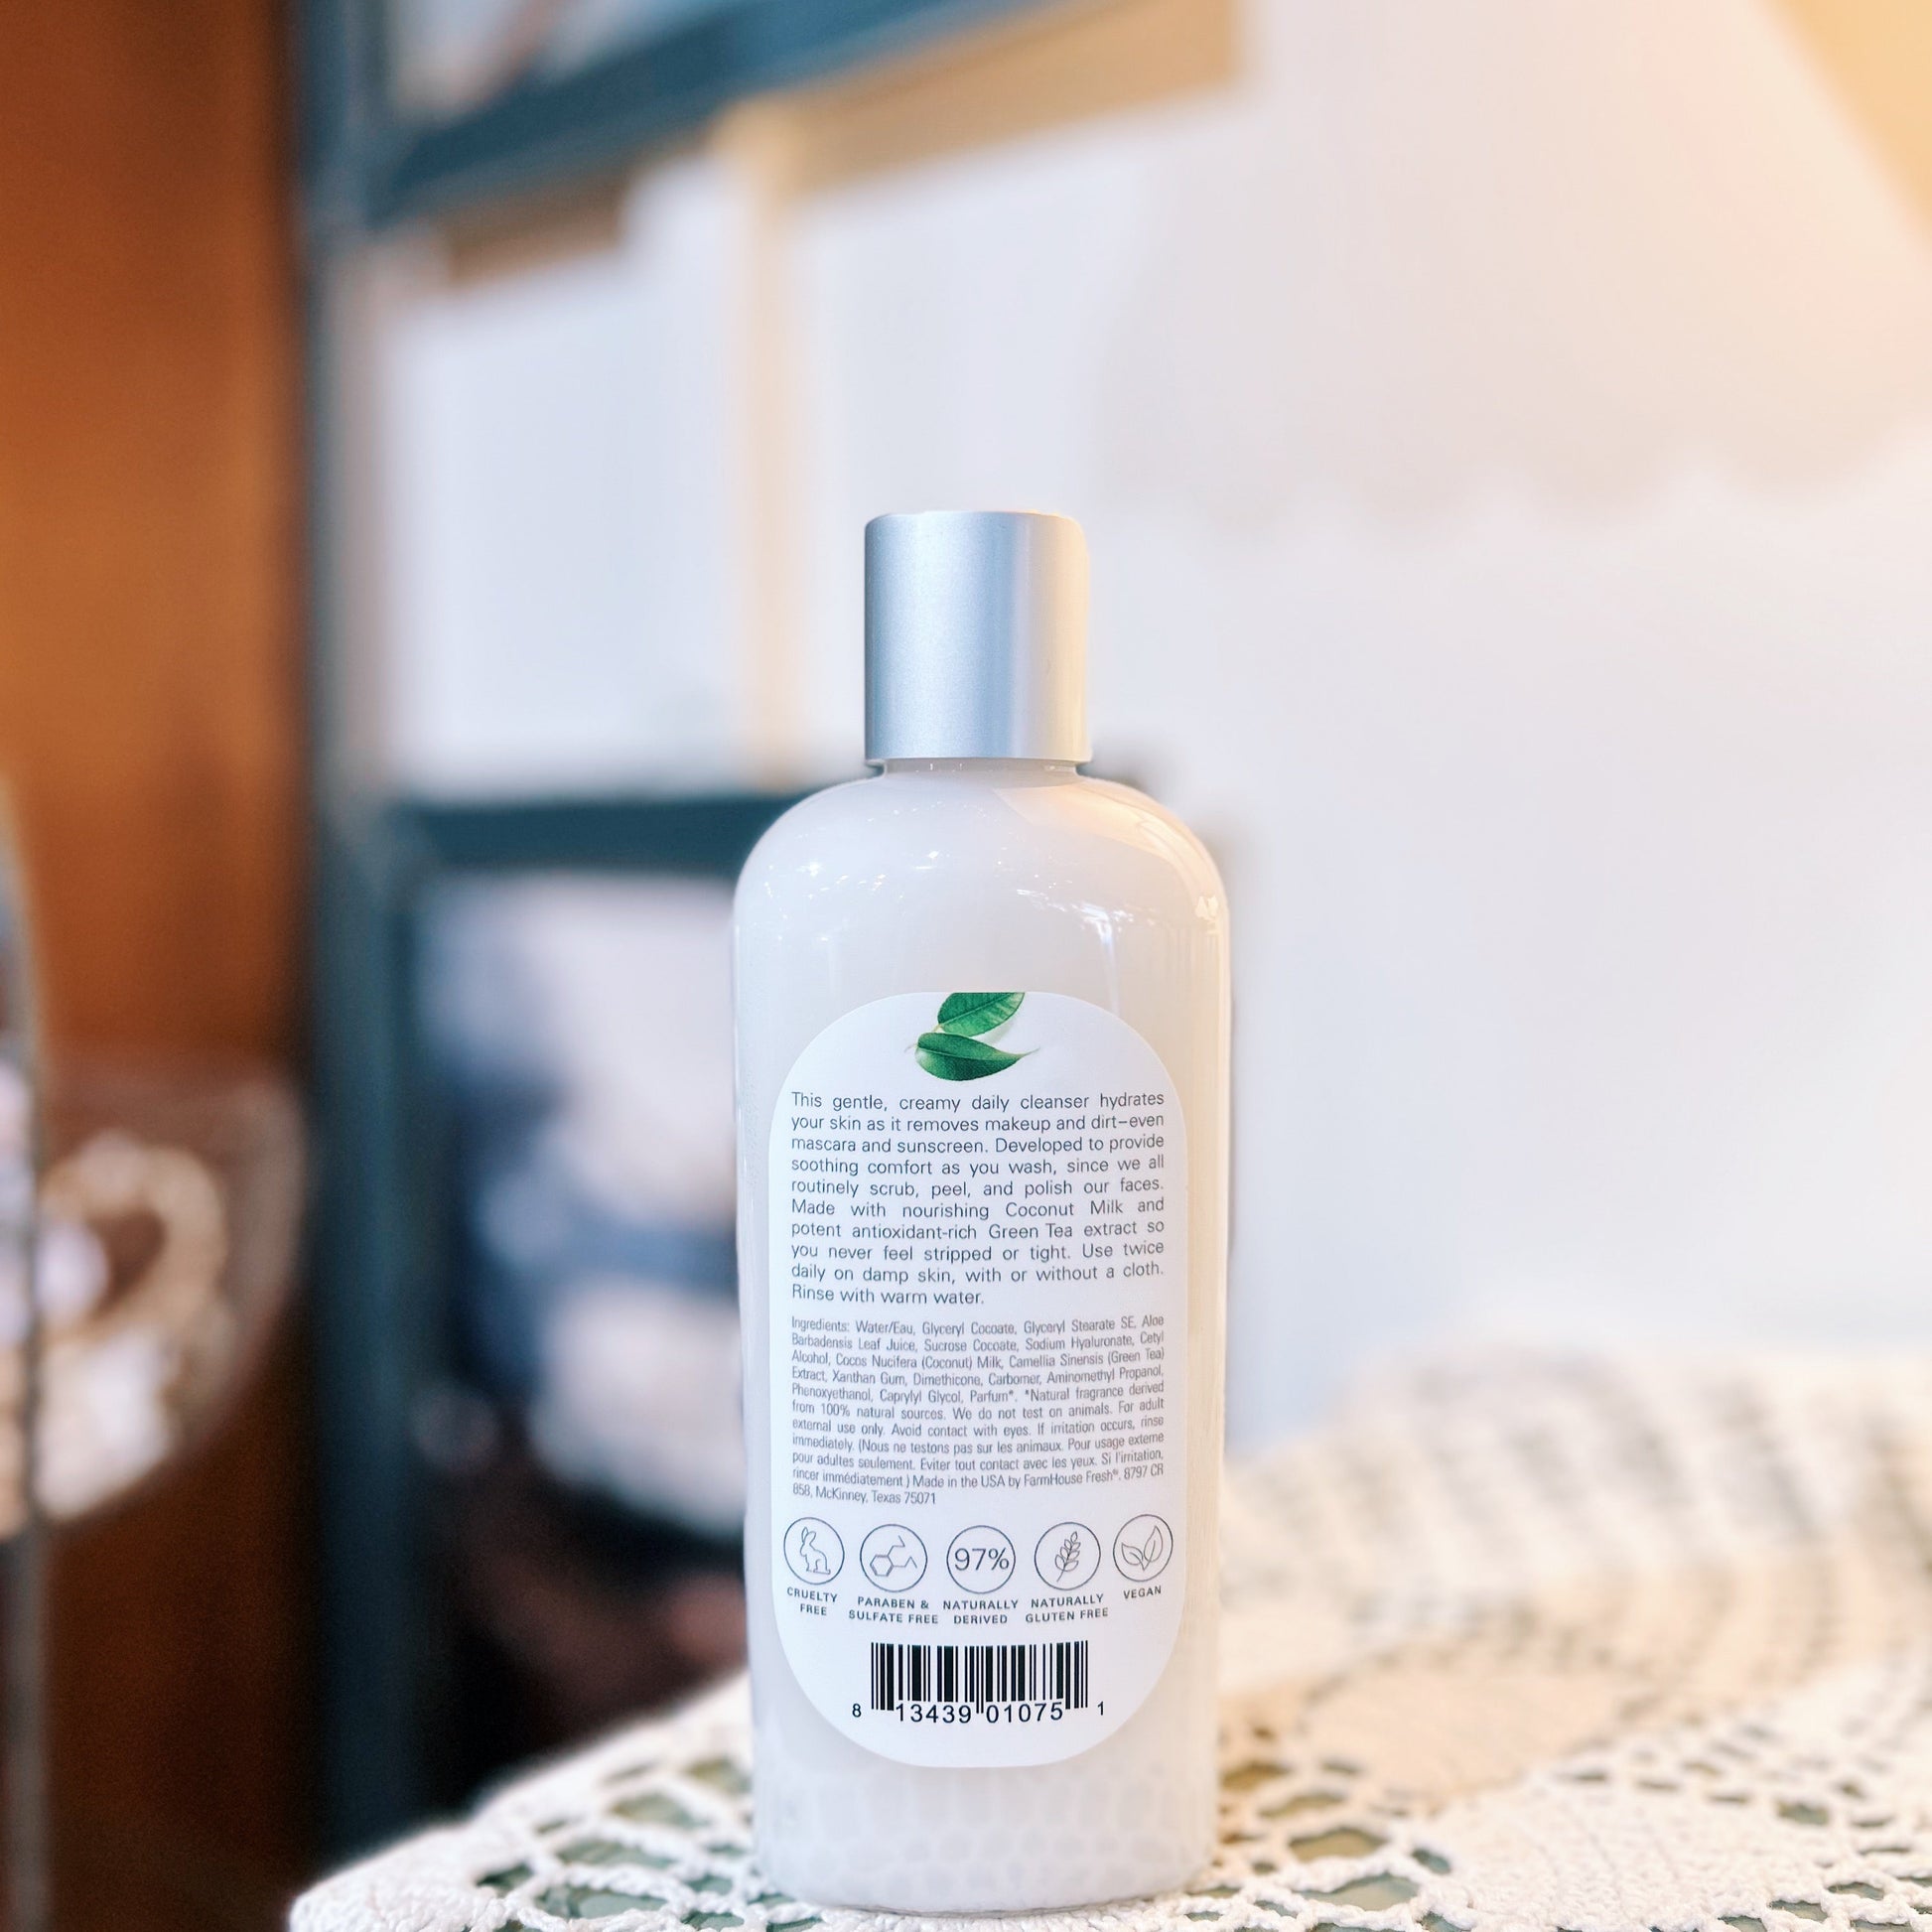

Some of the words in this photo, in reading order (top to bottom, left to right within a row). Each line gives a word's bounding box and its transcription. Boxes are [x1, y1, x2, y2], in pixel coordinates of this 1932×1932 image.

[791, 1090, 822, 1108] This
[832, 1092, 888, 1114] gentle,
[898, 1097, 961, 1114] creamy
[971, 1093, 1010, 1114] daily
[1020, 1092, 1089, 1110] cleanser
[1099, 1088, 1165, 1112] hydrates
[790, 1115, 824, 1133] your
[829, 1113, 861, 1131] skin
[866, 1118, 886, 1131] as
[891, 1115, 901, 1132] it
[906, 1119, 979, 1132] removes
[984, 1114, 1051, 1135] makeup
[1055, 1113, 1085, 1131] and
[791, 1136, 856, 1152] mascara
[861, 1136, 892, 1153] and
[897, 1140, 988, 1153] sunscreen.
[995, 1135, 1083, 1157] Developed
[1088, 1134, 1104, 1151] to
[1109, 1131, 1164, 1154] provide
[791, 1154, 859, 1176] soothing
[867, 1157, 932, 1174] comfort
[940, 1162, 960, 1174] as
[969, 1162, 999, 1178] you
[1008, 1157, 1056, 1177] wash,
[1066, 1155, 1109, 1173] since
[1116, 1157, 1141, 1171] we
[1148, 1152, 1164, 1169] all
[791, 1174, 859, 1198] routinely
[869, 1178, 919, 1199] scrub,
[930, 1179, 971, 1199] peel,
[982, 1178, 1014, 1195] and
[1024, 1177, 1072, 1198] polish
[1082, 1179, 1109, 1193] our
[1119, 1173, 1163, 1191] faces.
[791, 1196, 835, 1215] Made
[850, 1199, 886, 1217] with
[901, 1200, 989, 1221] nourishing
[1005, 1199, 1074, 1217] Coconut
[1089, 1196, 1123, 1215] Milk
[1137, 1193, 1164, 1212] and
[791, 1217, 841, 1240] potent
[851, 1220, 977, 1239] antioxidant-rich
[988, 1221, 1038, 1239] Green
[1044, 1220, 1072, 1238] Tea
[1083, 1217, 1137, 1236] extract
[1147, 1218, 1165, 1232] so
[790, 1242, 818, 1261] you
[828, 1245, 873, 1260] never
[883, 1243, 913, 1261] feel
[923, 1244, 992, 1265] stripped
[1002, 1247, 1020, 1261] or
[1030, 1242, 1070, 1264] tight.
[1081, 1240, 1113, 1258] Use
[1122, 1236, 1164, 1256] twice
[790, 1260, 826, 1283] daily
[833, 1266, 854, 1280] on
[862, 1264, 909, 1286] damp
[917, 1265, 955, 1286] skin,
[964, 1265, 1002, 1282] with
[1010, 1268, 1028, 1282] or
[1035, 1262, 1097, 1281] without
[1105, 1265, 1115, 1278] a
[1122, 1257, 1163, 1277] cloth.
[791, 1282, 835, 1301] Rinse
[839, 1285, 875, 1303] with
[880, 1290, 927, 1304] warm
[932, 1287, 984, 1304] water.
[921, 1321, 965, 1337] Glyceryl
[1023, 1319, 1065, 1337] Glyceryl
[791, 1332, 853, 1349] Barbadensis
[858, 1336, 881, 1350] Leaf
[923, 1338, 967, 1351] Sucrose
[1025, 1336, 1065, 1350] Sodium
[835, 1352, 868, 1367] Cocos
[871, 1354, 917, 1368] Nucifera
[920, 1355, 973, 1371] (Coconut)
[1008, 1353, 1055, 1368] Camellia
[1059, 1351, 1104, 1366] Sinensis
[831, 1369, 876, 1384] Xanthan
[879, 1388, 922, 1405] Caprylyl
[1074, 1383, 1124, 1402] fragrance
[791, 1399, 815, 1414] from
[820, 1402, 851, 1416] 100%
[856, 1404, 895, 1418] natural
[951, 1406, 972, 1419] We
[977, 1406, 993, 1419] do
[997, 1406, 1016, 1419] not
[1022, 1405, 1043, 1418] test
[1047, 1406, 1062, 1417] on
[1118, 1399, 1134, 1413] For
[1138, 1395, 1165, 1411] adult
[836, 1422, 856, 1434] use
[890, 1423, 922, 1437] Avoid
[926, 1424, 968, 1437] contact
[972, 1424, 998, 1437] with
[1036, 1422, 1044, 1435] If
[1140, 1413, 1164, 1428] rinse
[857, 1438, 890, 1455] (Nous
[893, 1442, 906, 1452] ne
[909, 1440, 950, 1453] testons
[952, 1443, 973, 1456] pas
[976, 1443, 993, 1453] sur
[996, 1440, 1013, 1453] les
[1067, 1437, 1091, 1450] Pour
[1094, 1436, 1125, 1451] usage
[954, 1457, 976, 1470] tout
[979, 1456, 1020, 1470] contact
[1022, 1457, 1048, 1469] avec
[1050, 1454, 1067, 1468] les
[1100, 1451, 1112, 1465] Si
[911, 1473, 944, 1487] Made
[947, 1474, 958, 1487] in
[960, 1474, 978, 1487] the
[980, 1473, 1006, 1487] USA
[1007, 1473, 1022, 1489] by
[1023, 1470, 1083, 1486] FarmHouse
[1123, 1464, 1148, 1479] 8797
[1150, 1462, 1164, 1476] CR
[871, 1489, 901, 1503] Texas
[903, 1490, 936, 1504] 75071
[954, 1547, 1010, 1572] 97%
[786, 1587, 838, 1602] CRUELTY
[857, 1595, 915, 1609] PARABEN
[920, 1599, 929, 1609] &
[1031, 1593, 1104, 1608] NATURALLY
[1123, 1586, 1162, 1599] VEGAN
[799, 1603, 827, 1616] FREE
[943, 1598, 1019, 1610] NATURALLY
[848, 1609, 903, 1623] SULFATE
[907, 1613, 938, 1624] FREE
[953, 1613, 1008, 1625] DERIVED
[1025, 1611, 1075, 1623] GLUTEN
[1079, 1607, 1109, 1619] FREE
[852, 1704, 862, 1718] 8
[896, 1704, 972, 1724] 13439
[985, 1703, 1064, 1724] 01075
[1097, 1701, 1104, 1716] 1
